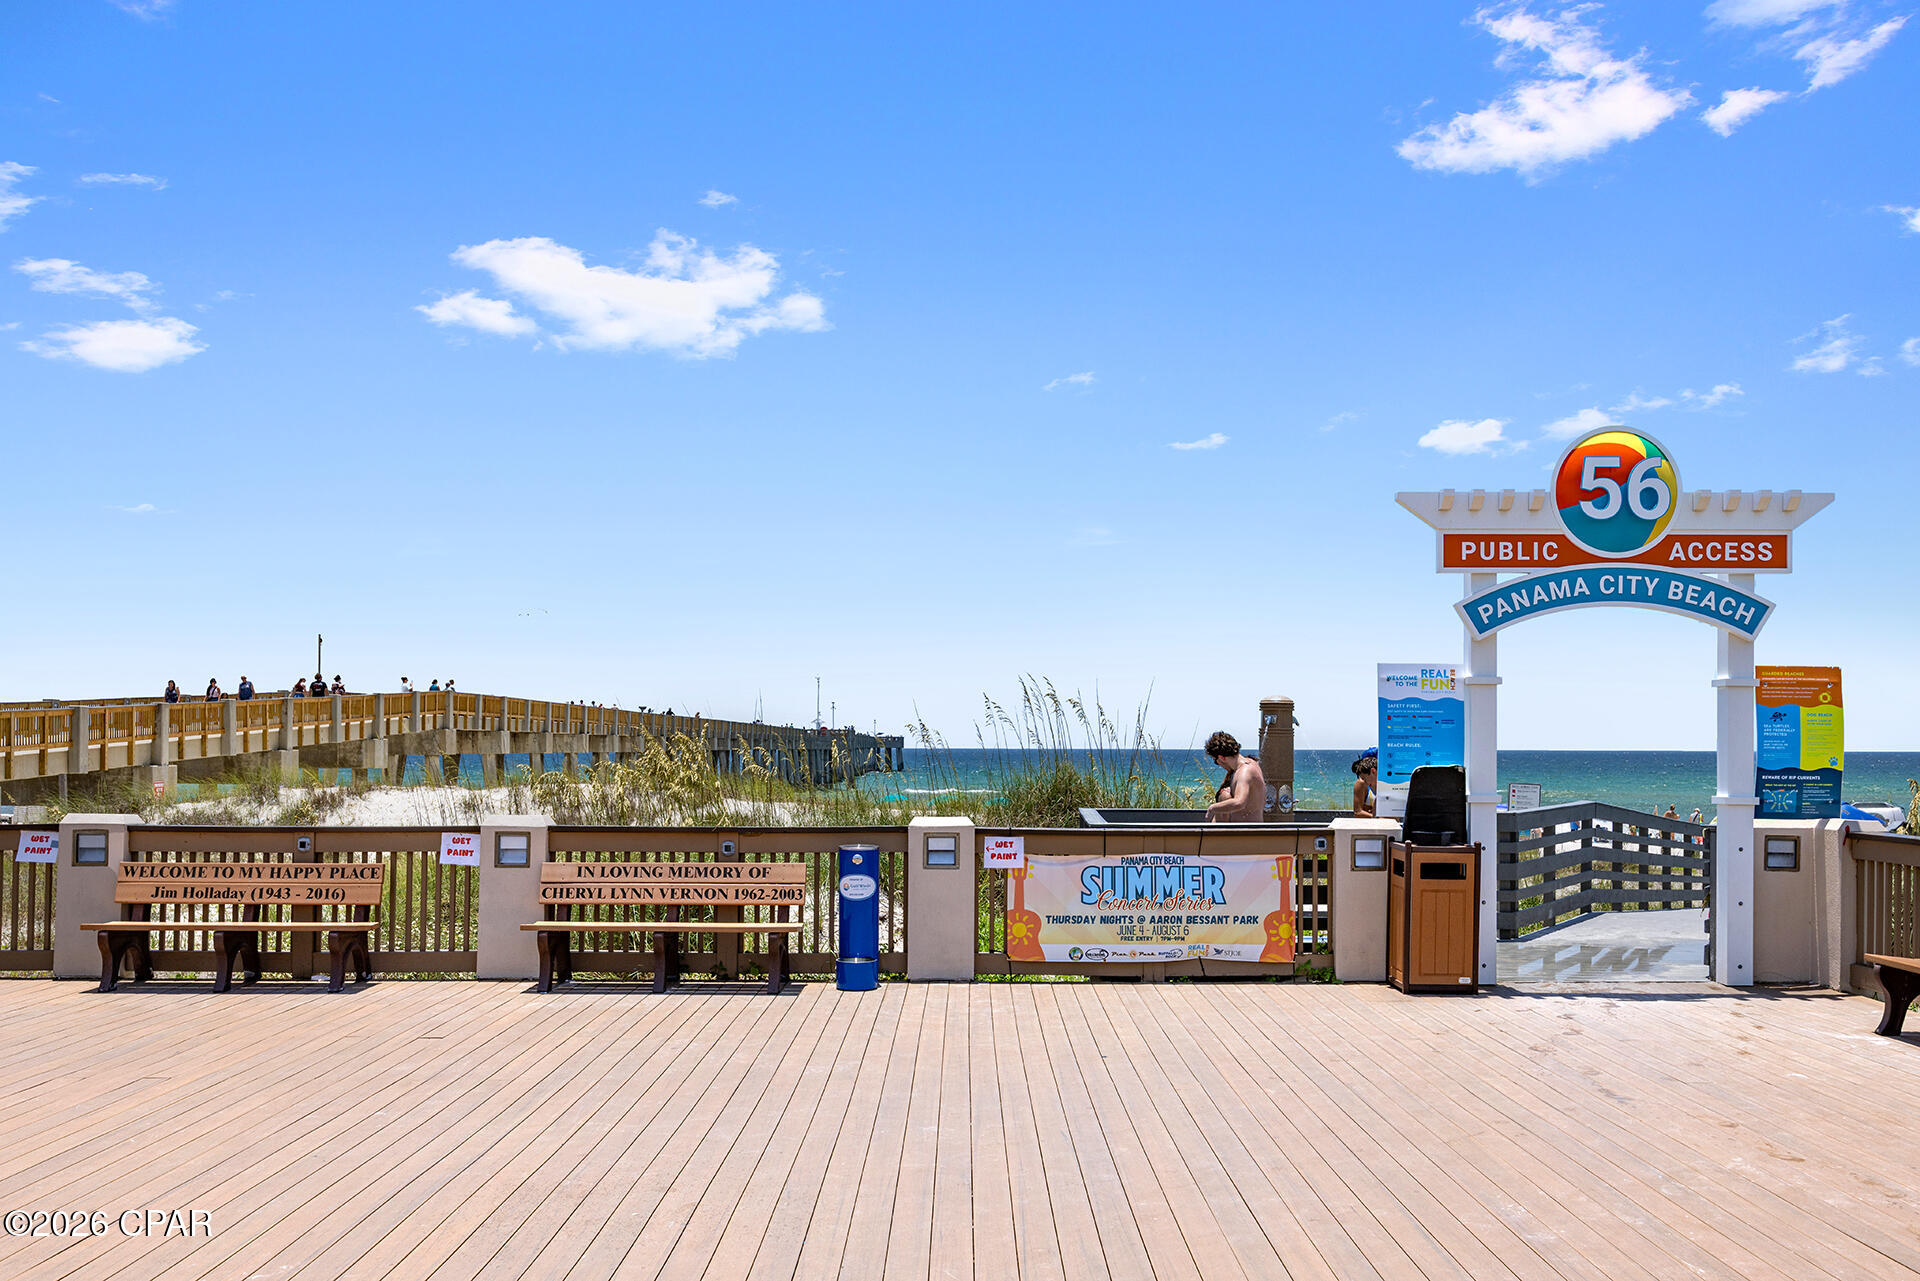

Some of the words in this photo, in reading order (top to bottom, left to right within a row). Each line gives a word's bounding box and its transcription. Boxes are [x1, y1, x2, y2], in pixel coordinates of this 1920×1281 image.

[1578, 455, 1671, 520] 56
[1461, 541, 1559, 561] PUBLIC
[1668, 541, 1773, 561] ACCESS
[1477, 576, 1590, 625] PANAMA
[1599, 575, 1660, 596] CITY
[1667, 580, 1756, 625] BEACH
[1421, 668, 1450, 678] REAL
[1421, 678, 1450, 690] FUN
[31, 835, 50, 843] WET
[452, 836, 471, 845] WET
[995, 840, 1014, 848] WET
[24, 846, 53, 855] PAINT
[447, 848, 475, 857] PAINT
[990, 852, 1018, 860] PAINT
[1120, 856, 1149, 866] PANAMA
[1149, 856, 1164, 865] CITY
[1164, 856, 1185, 865] BEACH
[123, 865, 208, 879] WELCOME
[211, 866, 235, 879] TO
[239, 866, 266, 880] MY
[269, 866, 325, 880] HAPPY
[329, 866, 381, 880] PLACE
[577, 865, 596, 878] IN
[600, 865, 663, 879] LOVING
[668, 866, 745, 879] MEMORY
[748, 866, 772, 879] OF
[1080, 865, 1227, 906] SUMMER
[150, 886, 178, 899] Jim
[182, 886, 247, 902] Holladay
[250, 887, 291, 902] (1943
[305, 887, 346, 902] 2016)
[541, 887, 607, 900] CHERYL
[610, 887, 655, 900] LYNN
[659, 887, 729, 900] VERNON
[734, 888, 804, 901] 1962-2003
[1097, 889, 1161, 911] Concert
[1162, 888, 1215, 911] Series
[1045, 914, 1097, 925] THURSDAY
[1099, 914, 1134, 925] NIGHTS
[1137, 914, 1146, 924] @
[1149, 914, 1183, 925] AARON
[1186, 914, 1230, 925] BESSANT
[1233, 915, 1259, 925] PARK
[1116, 925, 1137, 936] JUNE
[1138, 925, 1144, 936] 4
[1151, 925, 1183, 936] AUGUST
[1183, 925, 1190, 936] 6
[1187, 950, 1205, 958] FUN
